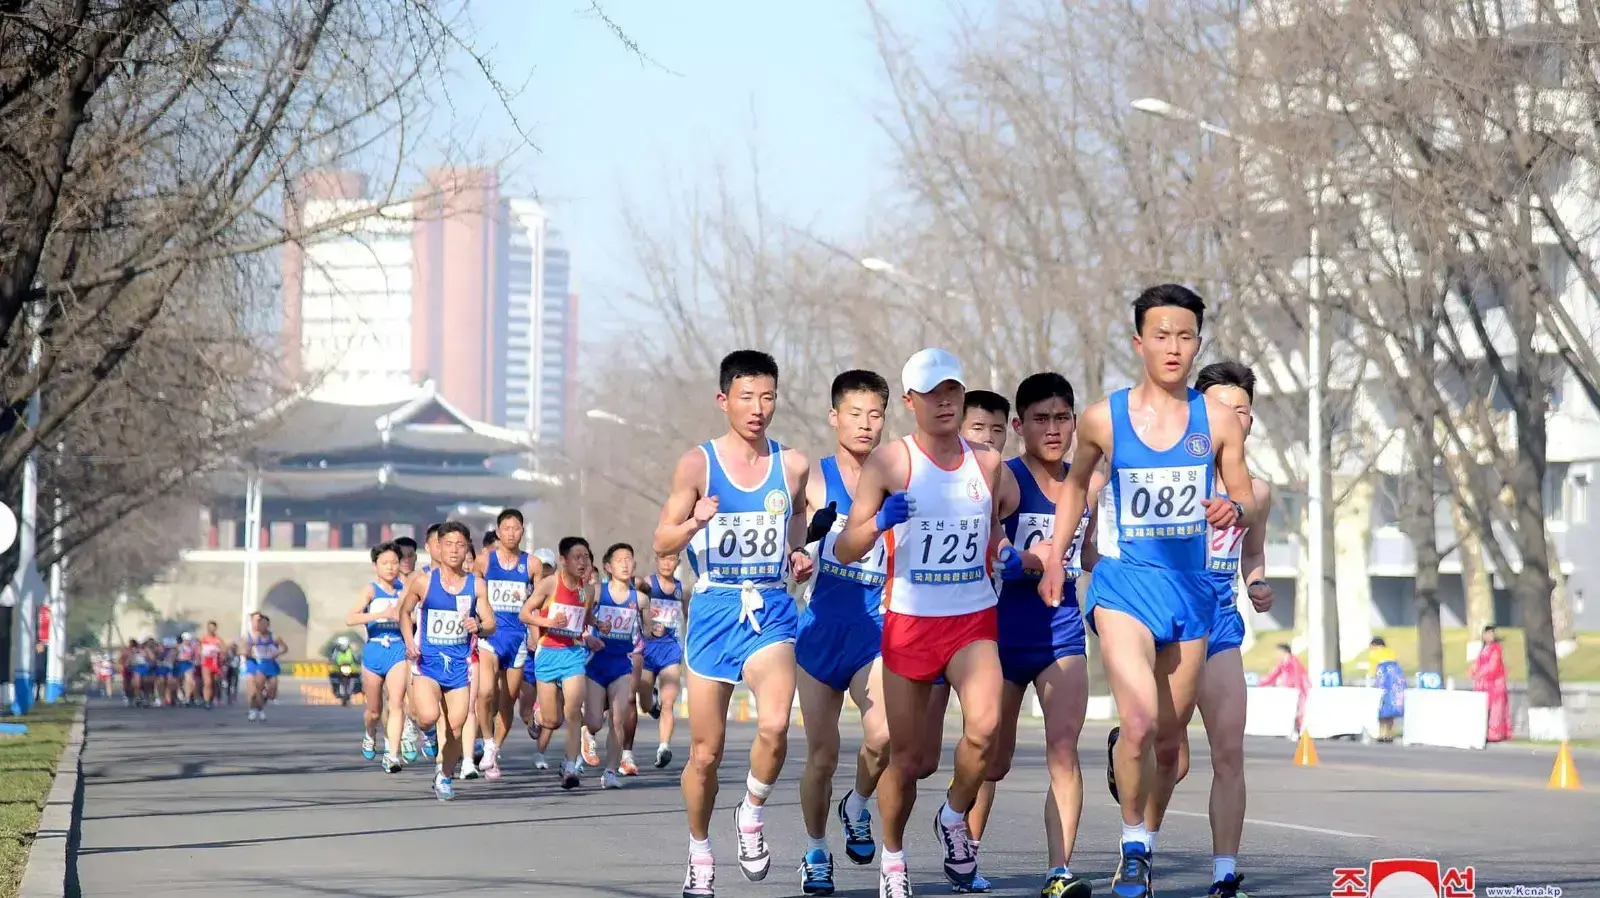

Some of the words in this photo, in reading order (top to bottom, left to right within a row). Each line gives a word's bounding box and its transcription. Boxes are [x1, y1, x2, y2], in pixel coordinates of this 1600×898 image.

[1131, 485, 1197, 518] 082
[718, 527, 777, 558] 038
[921, 532, 979, 564] 125
[1211, 526, 1245, 552] 27
[433, 619, 465, 635] 098
